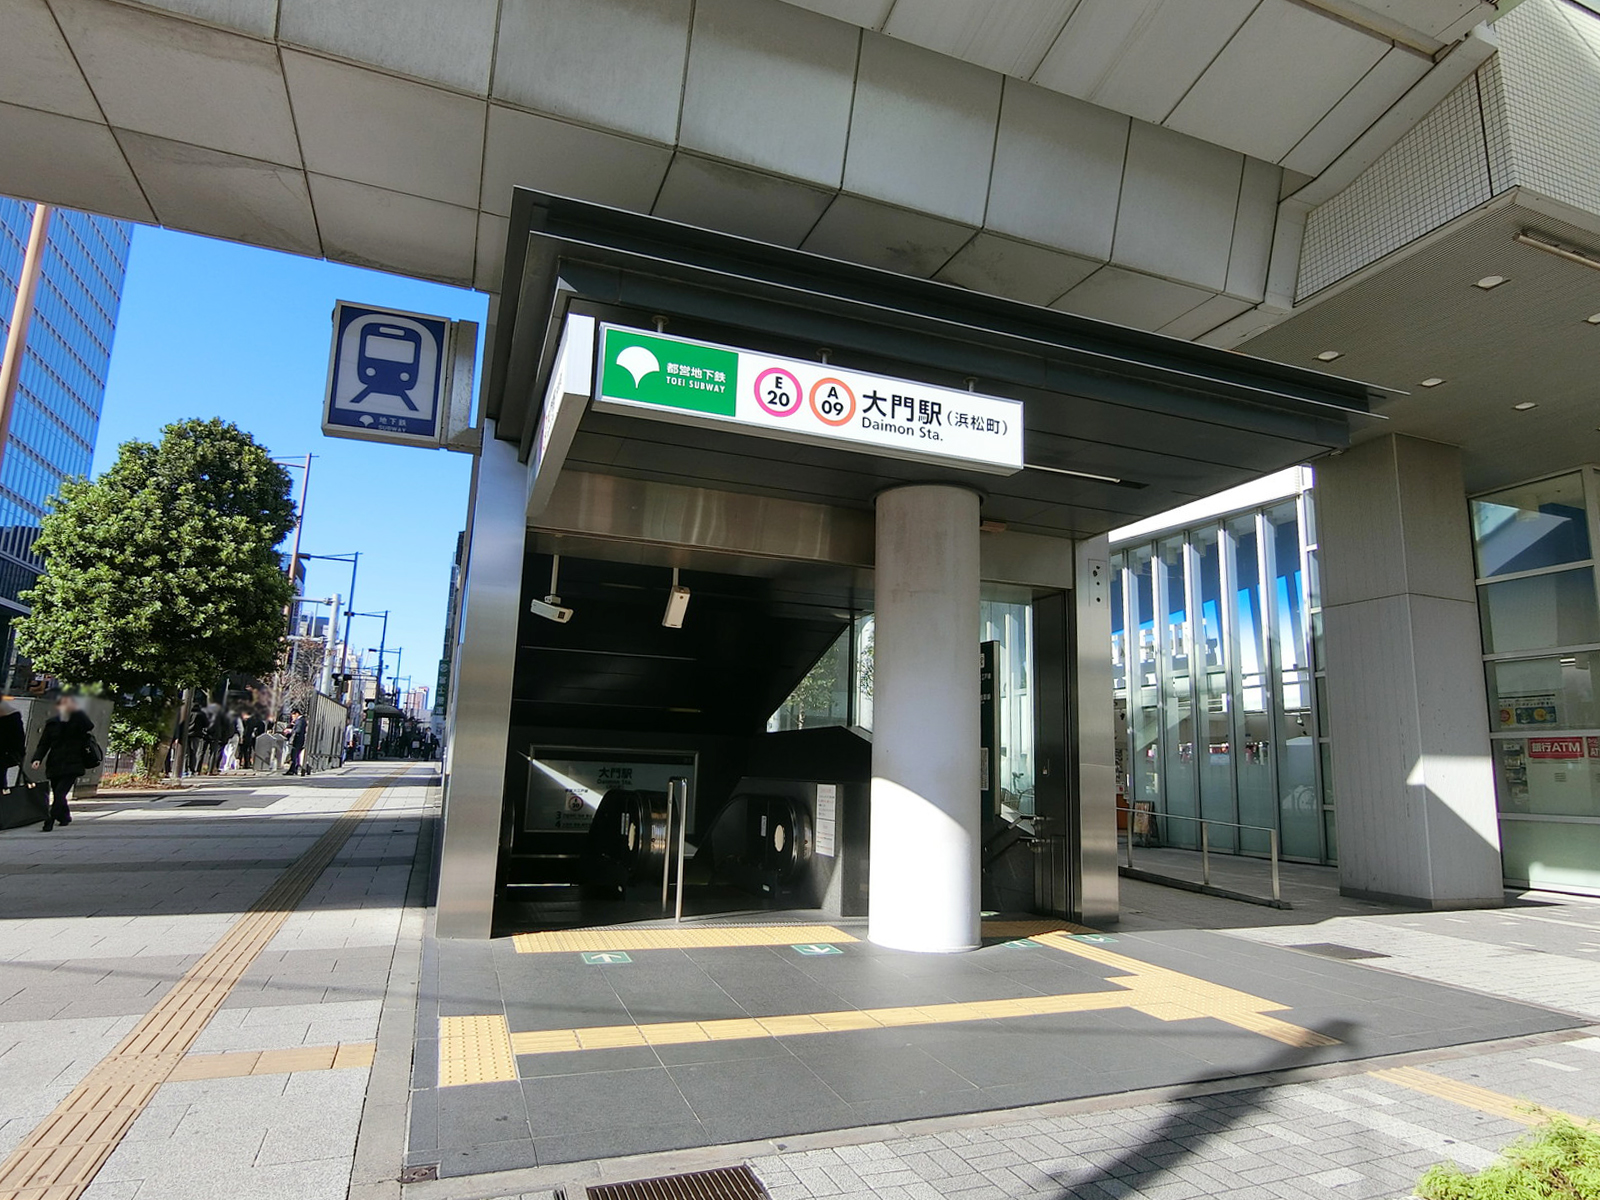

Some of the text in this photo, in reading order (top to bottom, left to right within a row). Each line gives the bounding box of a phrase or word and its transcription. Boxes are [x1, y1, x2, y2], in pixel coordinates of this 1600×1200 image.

[666, 362, 726, 383] 都営地下鉄
[666, 376, 726, 393] TOEI SUBWAY
[774, 376, 783, 389] E
[767, 390, 790, 407] 20
[827, 386, 839, 400] A
[821, 400, 844, 416] 09
[862, 390, 942, 426] 大門駅
[379, 416, 406, 426] 地下鉄
[862, 416, 944, 441] Daimon Sta.
[599, 766, 633, 779] 大門駅
